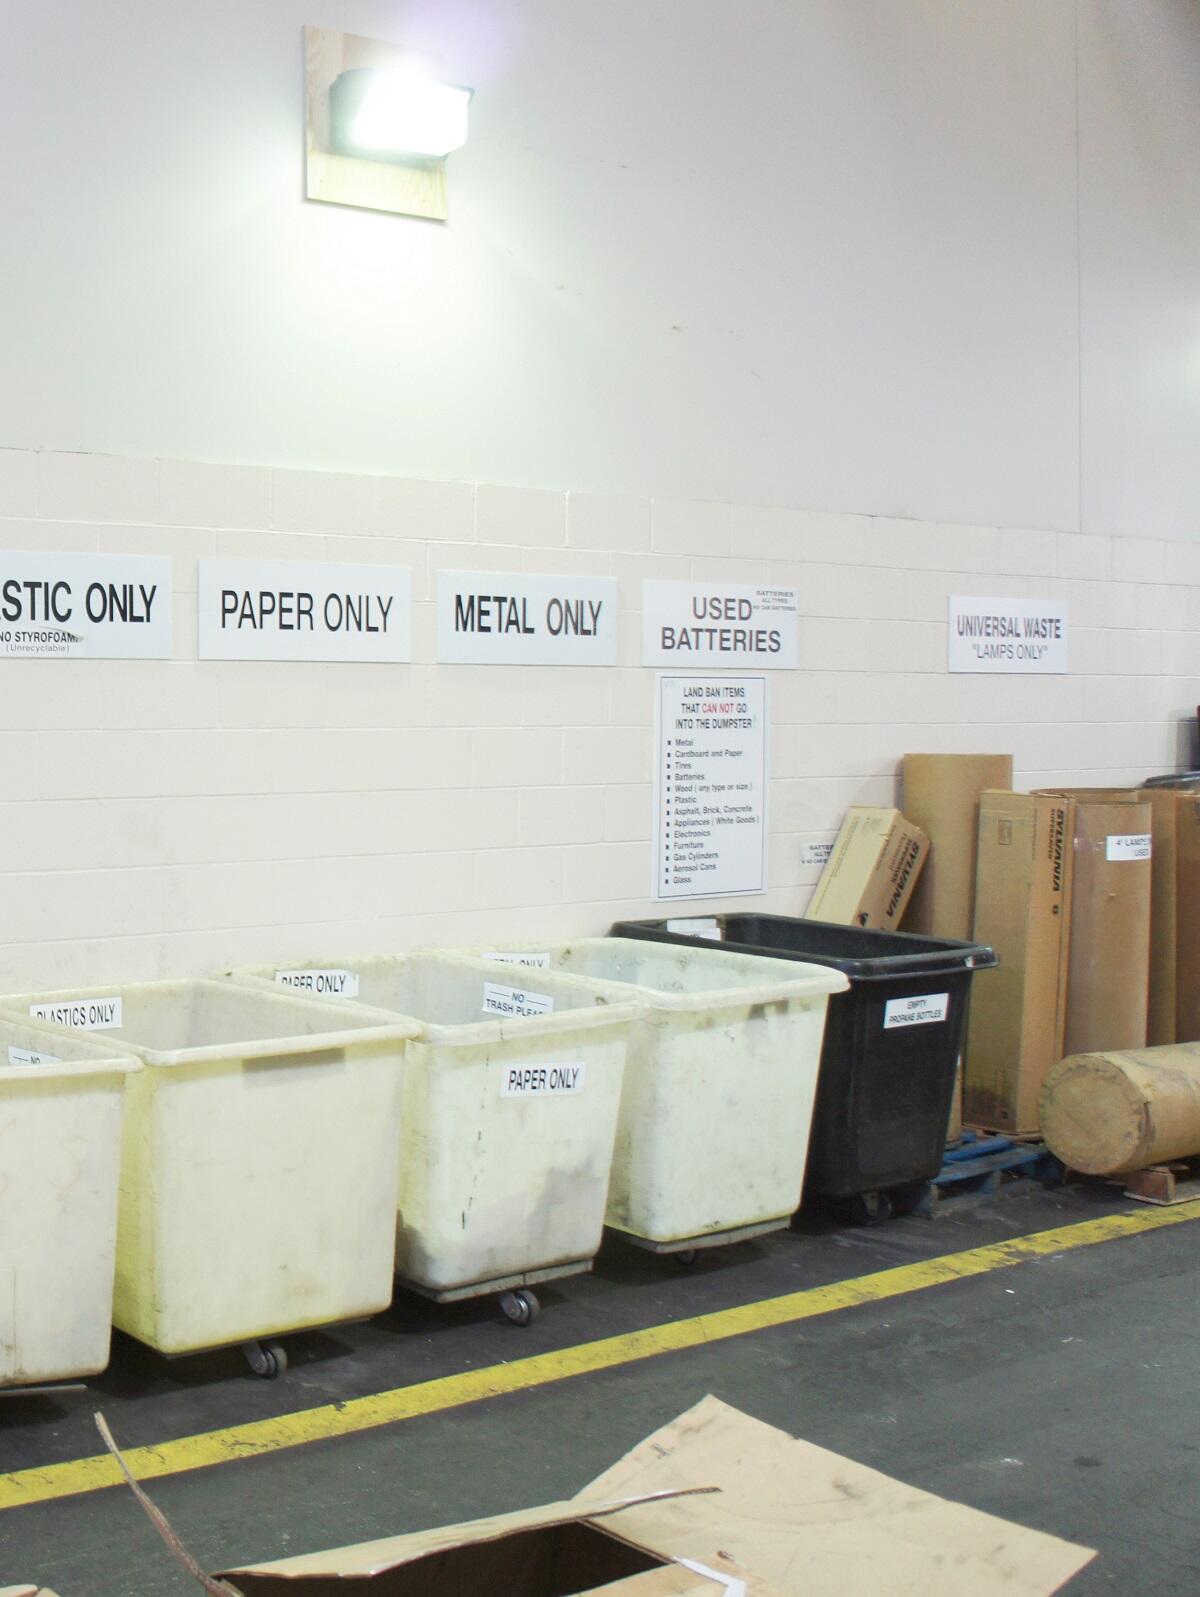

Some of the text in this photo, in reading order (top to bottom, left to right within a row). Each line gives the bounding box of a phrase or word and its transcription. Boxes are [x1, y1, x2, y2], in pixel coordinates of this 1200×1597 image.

[85, 582, 157, 623] ONLY
[221, 590, 393, 632] PAPER ONLY
[692, 596, 752, 621] USED
[455, 594, 602, 636] METAL ONLY
[956, 615, 1062, 639] UNIVERSAL WASTE
[661, 626, 781, 653] BATTERIES
[972, 643, 1049, 660] "LAMPS ONLY"
[683, 687, 745, 698] LAND BAN ITEMS
[681, 703, 747, 713] THAT CAN NOT GO
[675, 719, 693, 729] INTO
[696, 719, 710, 729] THE
[675, 738, 694, 747] Metal
[675, 749, 743, 758] Cardboard and Paper
[675, 761, 692, 769] Tires
[674, 773, 705, 781] Batteries
[674, 784, 693, 792] Wood
[674, 796, 697, 804] Plastic
[723, 805, 752, 813] Concrete
[674, 819, 710, 828] Appliances
[674, 830, 711, 838] Electronics
[673, 842, 704, 850] Furniture
[1052, 809, 1065, 892] SYLVANIA
[673, 852, 719, 861] Gas Cylinders
[673, 863, 717, 872] Aerosol Cans
[672, 876, 692, 884] Glass
[886, 841, 920, 918] SYLVANIA
[316, 975, 346, 993] ONLY
[511, 991, 525, 1003] NO
[486, 998, 514, 1013] TRASH
[89, 1003, 115, 1024] ONLY
[508, 1067, 581, 1091] PAPER ONLY
